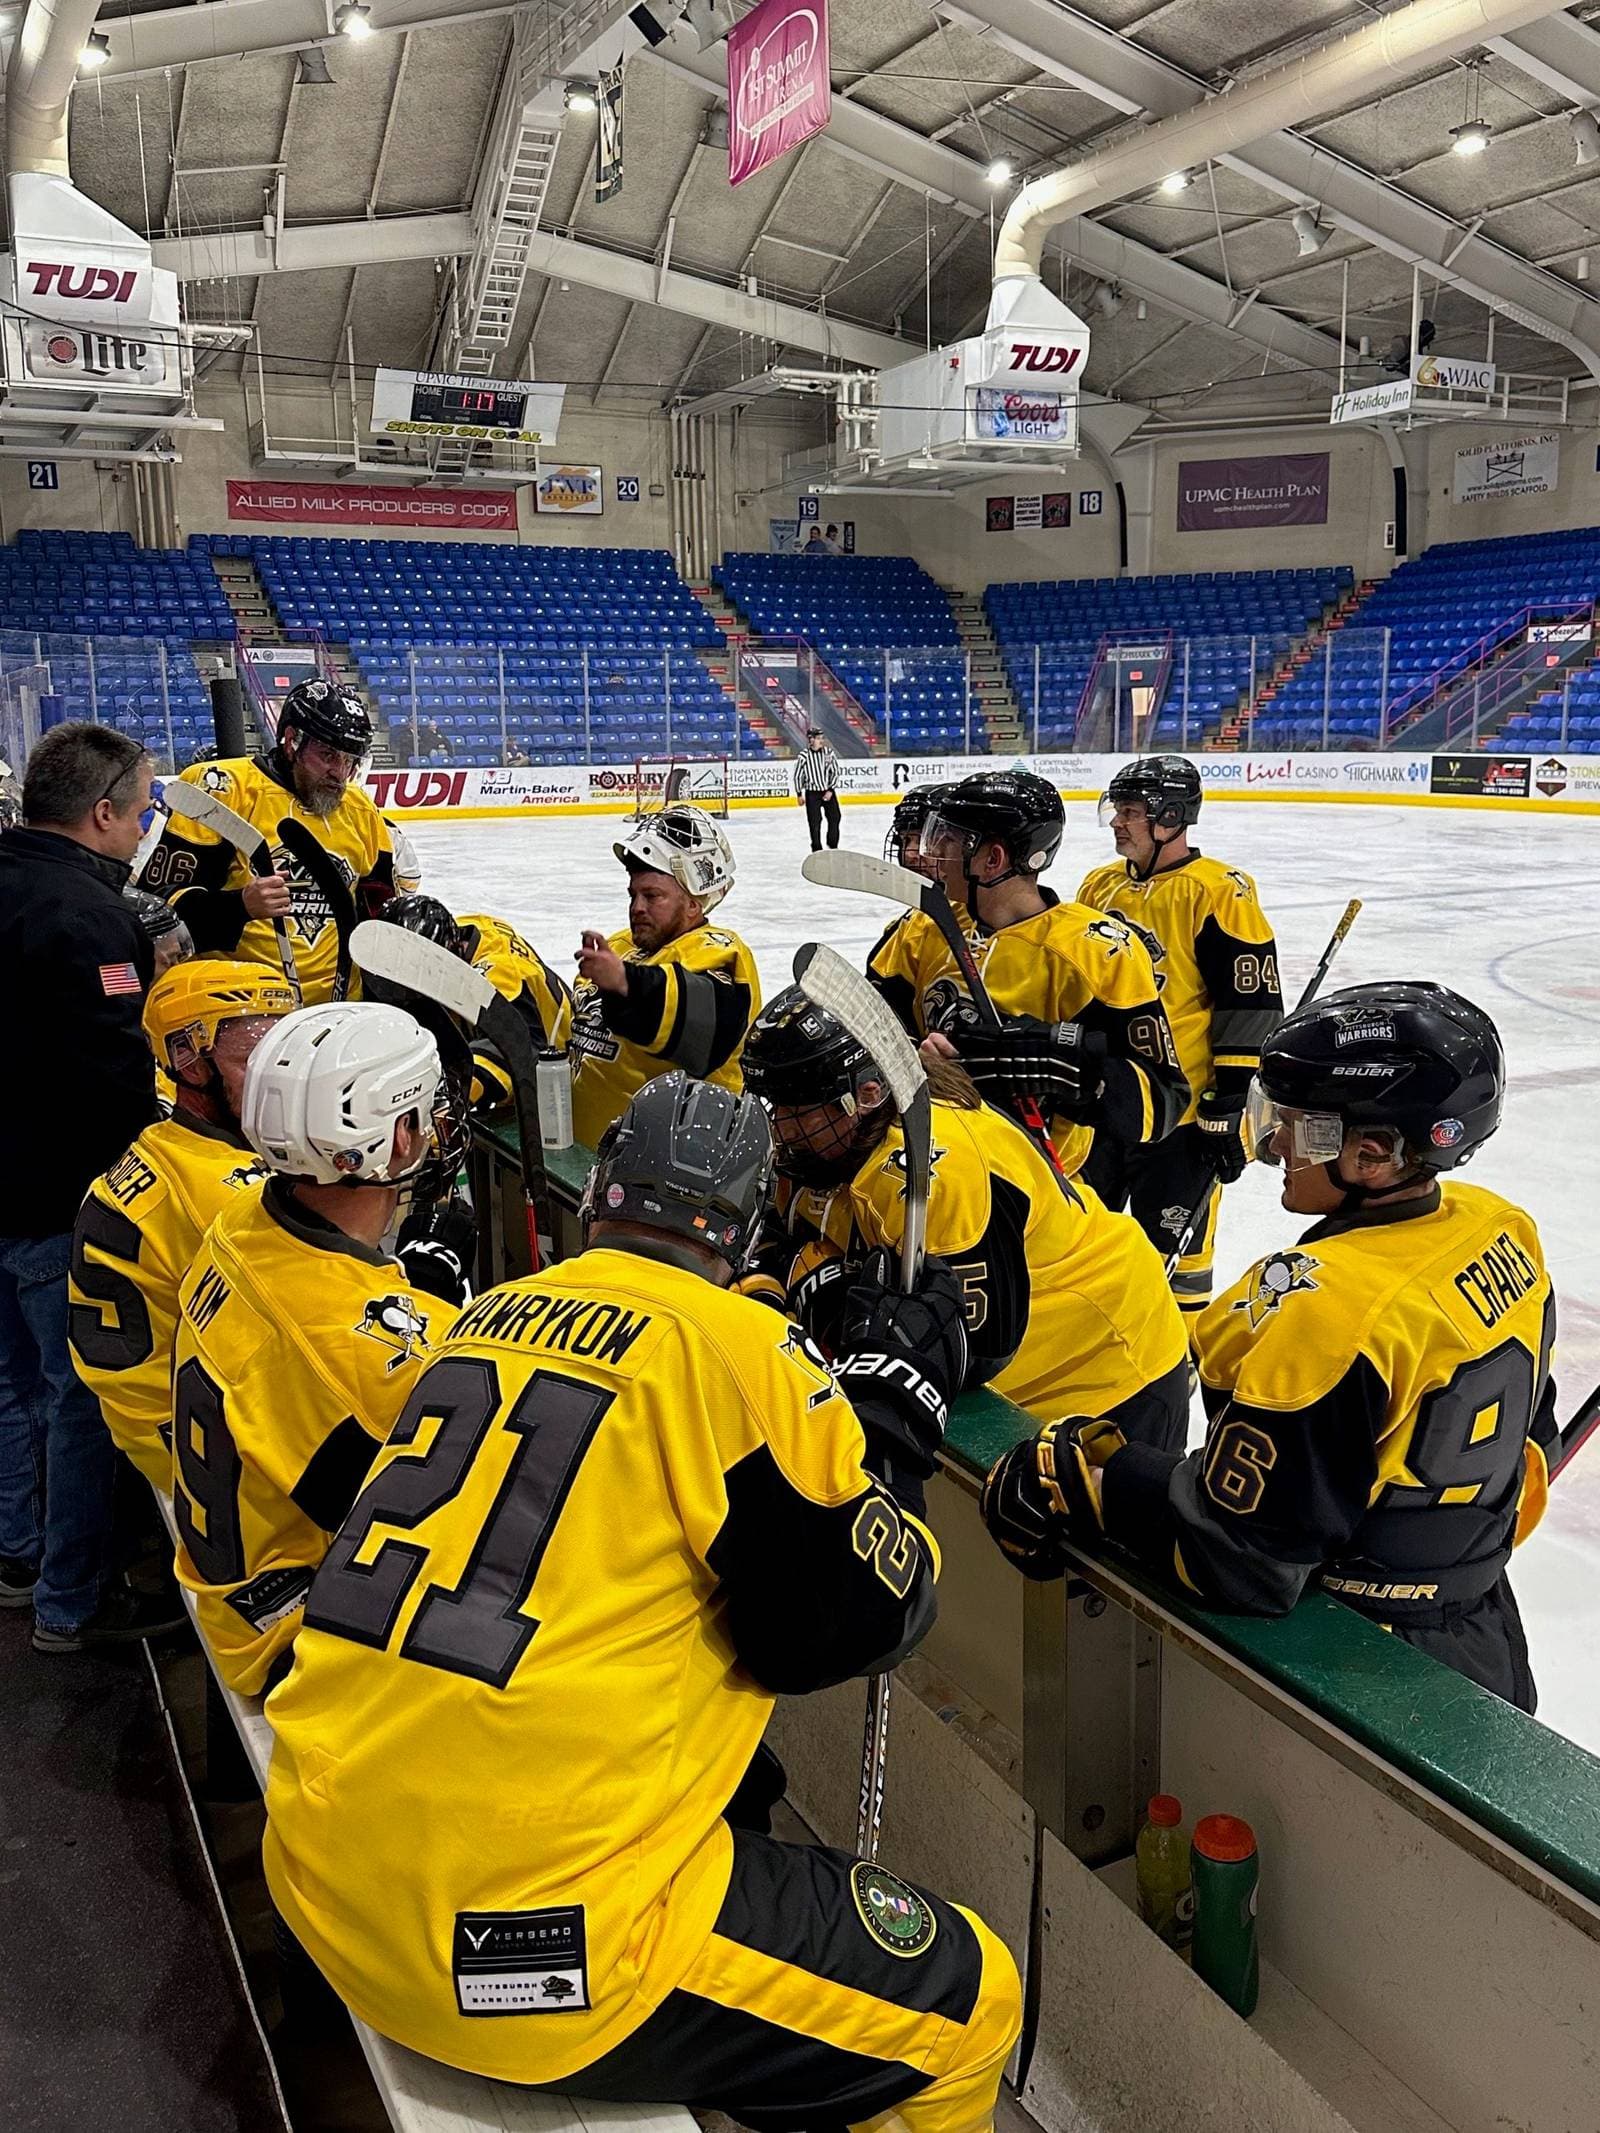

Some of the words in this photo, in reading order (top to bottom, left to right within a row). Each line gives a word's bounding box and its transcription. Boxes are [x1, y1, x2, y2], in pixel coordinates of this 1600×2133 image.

[766, 40, 808, 90] SUMMIT
[26, 262, 137, 303] TUDI
[80, 332, 148, 376] Lite
[1009, 344, 1081, 373] TUDI
[415, 372, 457, 386] UPMC
[460, 375, 502, 391] HEALTH
[504, 380, 530, 393] PLAN
[1448, 367, 1490, 388] WJAC
[415, 386, 442, 396] HOME
[497, 393, 523, 403] GUEST
[1352, 393, 1390, 412] Holiday
[1390, 388, 1409, 404] Inn
[461, 392, 494, 411] 1:17
[1004, 393, 1061, 422] Coors
[385, 421, 453, 435] SHOTS
[456, 426, 486, 438] ON
[490, 428, 541, 442] GOAL
[1014, 422, 1050, 434] LIGHT
[1458, 447, 1482, 458] SOLID
[32, 464, 54, 487] 21
[618, 481, 638, 496] 20
[1185, 487, 1232, 503] UPMC
[1235, 486, 1284, 500] HEALTH
[1287, 483, 1321, 497] PLAN
[1511, 484, 1548, 497] SCAFFOLD
[236, 495, 297, 508] ALLIED
[302, 498, 345, 511] MILK
[349, 500, 455, 515] PRODUCERS'
[461, 503, 511, 516] COOP.
[801, 501, 817, 515] 19
[1082, 493, 1100, 513] 18
[1213, 502, 1291, 513] upmchealthplan.com
[342, 697, 365, 717] 86
[729, 768, 789, 776] ENNSYLVANIA
[836, 765, 879, 776] merset
[1033, 757, 1083, 768] Conemaugh
[1034, 766, 1060, 774] Health
[1062, 766, 1092, 776] System
[1246, 758, 1292, 783] Live!
[1296, 766, 1338, 779] CASINO
[1347, 763, 1406, 782] HIGHMARK
[365, 771, 468, 808] TUDI
[480, 784, 574, 795] Martin-Baker
[521, 794, 580, 804] America
[146, 844, 198, 887] 86
[1233, 954, 1279, 994] 84
[1338, 1026, 1393, 1045] WARRIORS
[843, 1047, 867, 1067] CC
[1332, 1066, 1395, 1077] BAUER
[391, 1084, 423, 1104] CCM
[68, 1190, 153, 1371] 5
[1205, 1420, 1277, 1515] 6
[303, 1355, 618, 1691] 21
[851, 1495, 919, 1600] 2
[1320, 1573, 1439, 1600] BAUER
[494, 1926, 571, 1941] VERBERO
